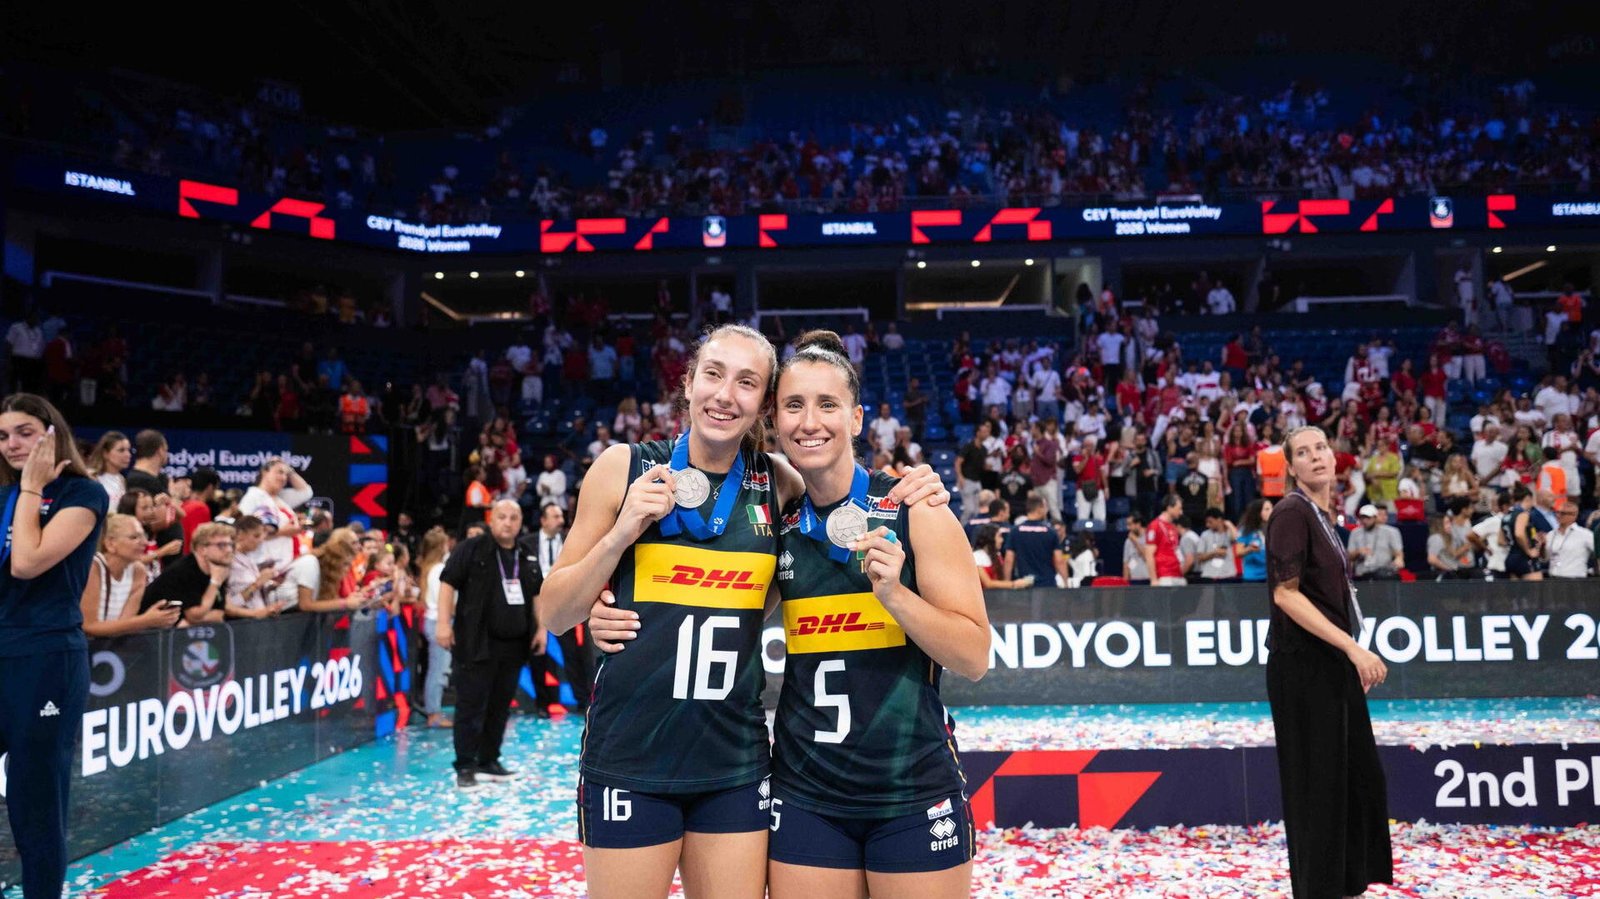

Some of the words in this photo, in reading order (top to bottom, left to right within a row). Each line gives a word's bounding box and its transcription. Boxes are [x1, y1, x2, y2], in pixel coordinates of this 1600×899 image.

[65, 170, 136, 196] ISTANBUL
[1082, 208, 1108, 221] CEV
[1109, 206, 1160, 221] Trendyol
[1160, 204, 1222, 220] EuroVolley
[367, 215, 393, 231] CEV
[393, 219, 441, 239] Trendyol
[442, 222, 502, 238] EuroVolley
[822, 222, 877, 235] ISTANBUL
[1115, 222, 1145, 235] 2026
[1145, 222, 1190, 234] Women
[427, 240, 470, 252] Women
[219, 449, 312, 471] EuroVlley
[753, 524, 774, 538] ITA
[668, 564, 755, 591] DHL
[796, 612, 868, 636] DHL
[672, 614, 740, 701] 16
[813, 659, 852, 744] 5
[82, 665, 307, 777] EUROVOLLEY
[310, 654, 362, 710] 2026
[1434, 756, 1538, 808] 2nd
[603, 786, 632, 821] 16
[770, 797, 783, 832] 5
[930, 835, 959, 852] errea
